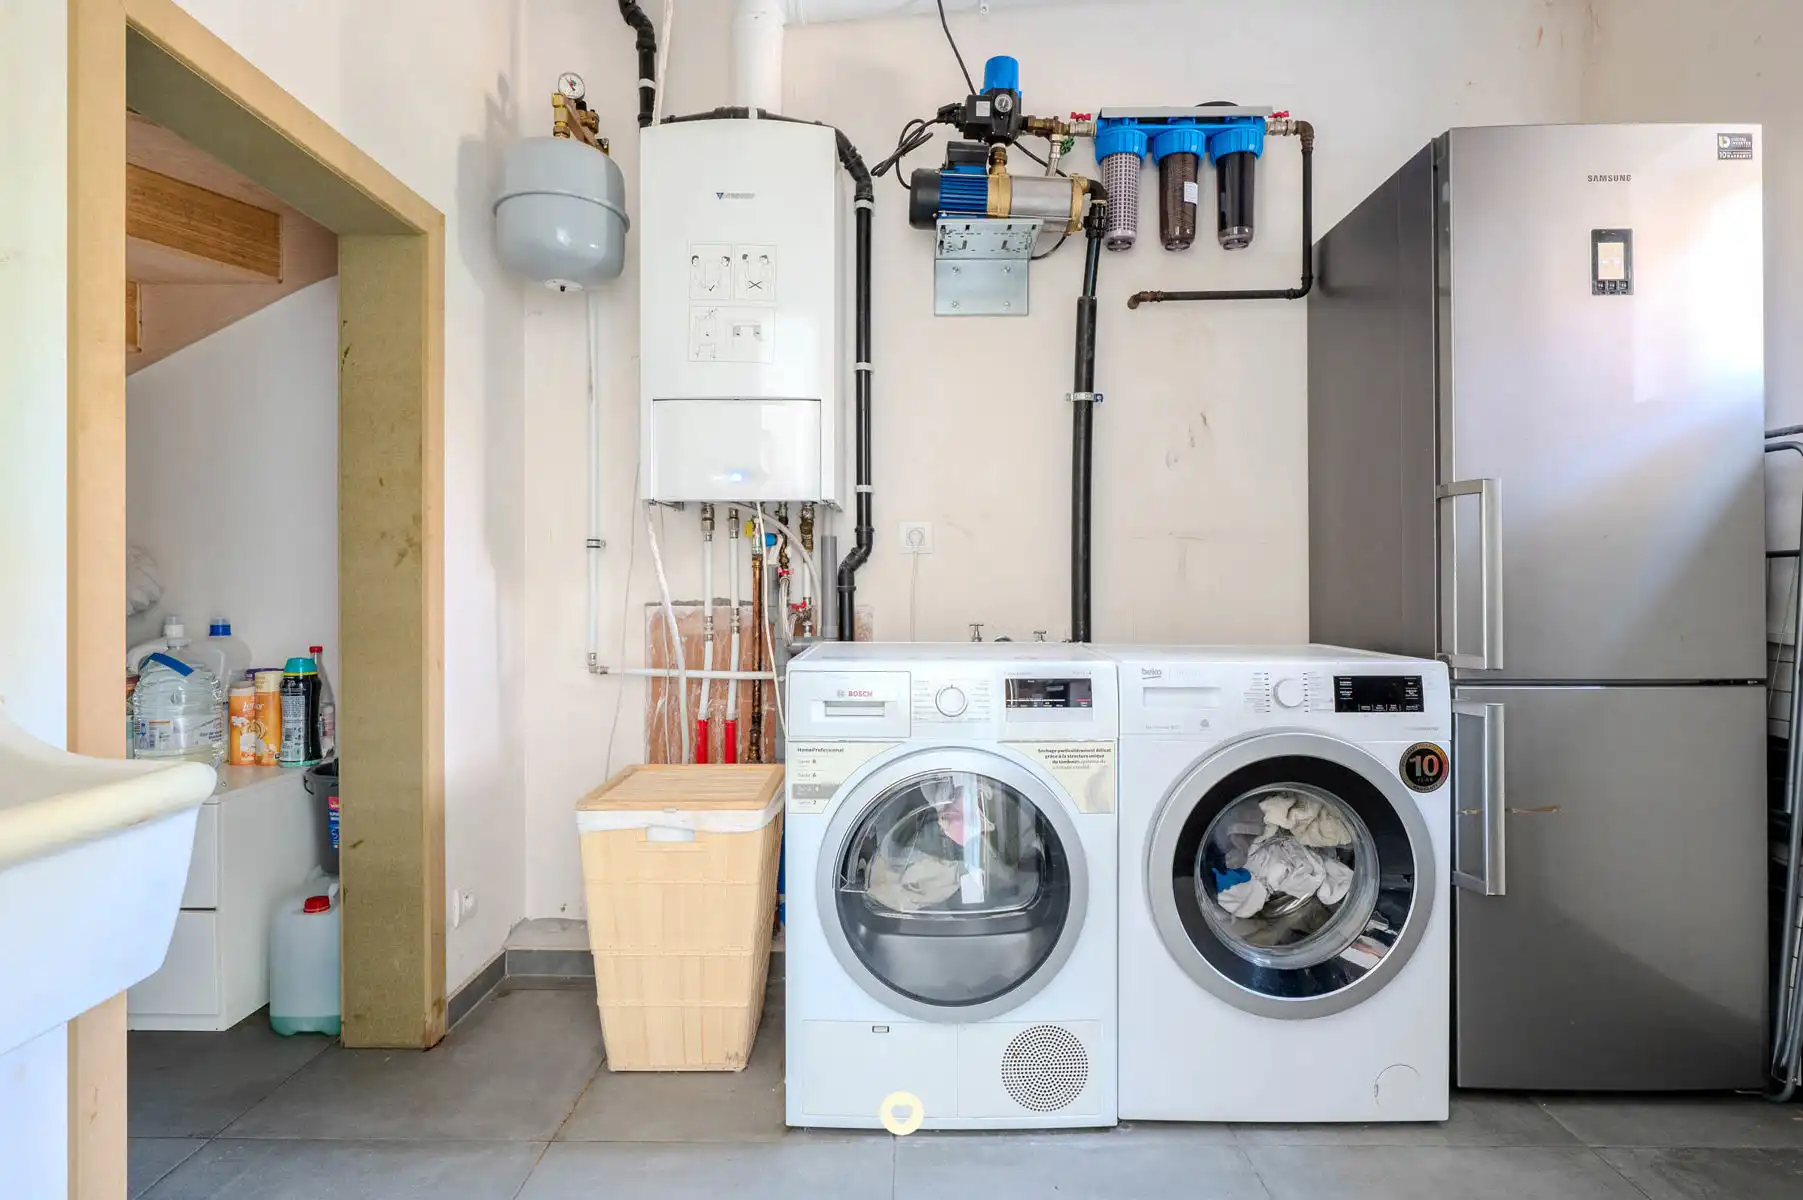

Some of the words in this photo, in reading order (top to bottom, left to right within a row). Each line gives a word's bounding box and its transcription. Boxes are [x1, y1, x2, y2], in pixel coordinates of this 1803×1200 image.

[1719, 151, 1727, 159] 10
[1587, 174, 1632, 182] SAMSUNG
[1409, 754, 1439, 776] 10
